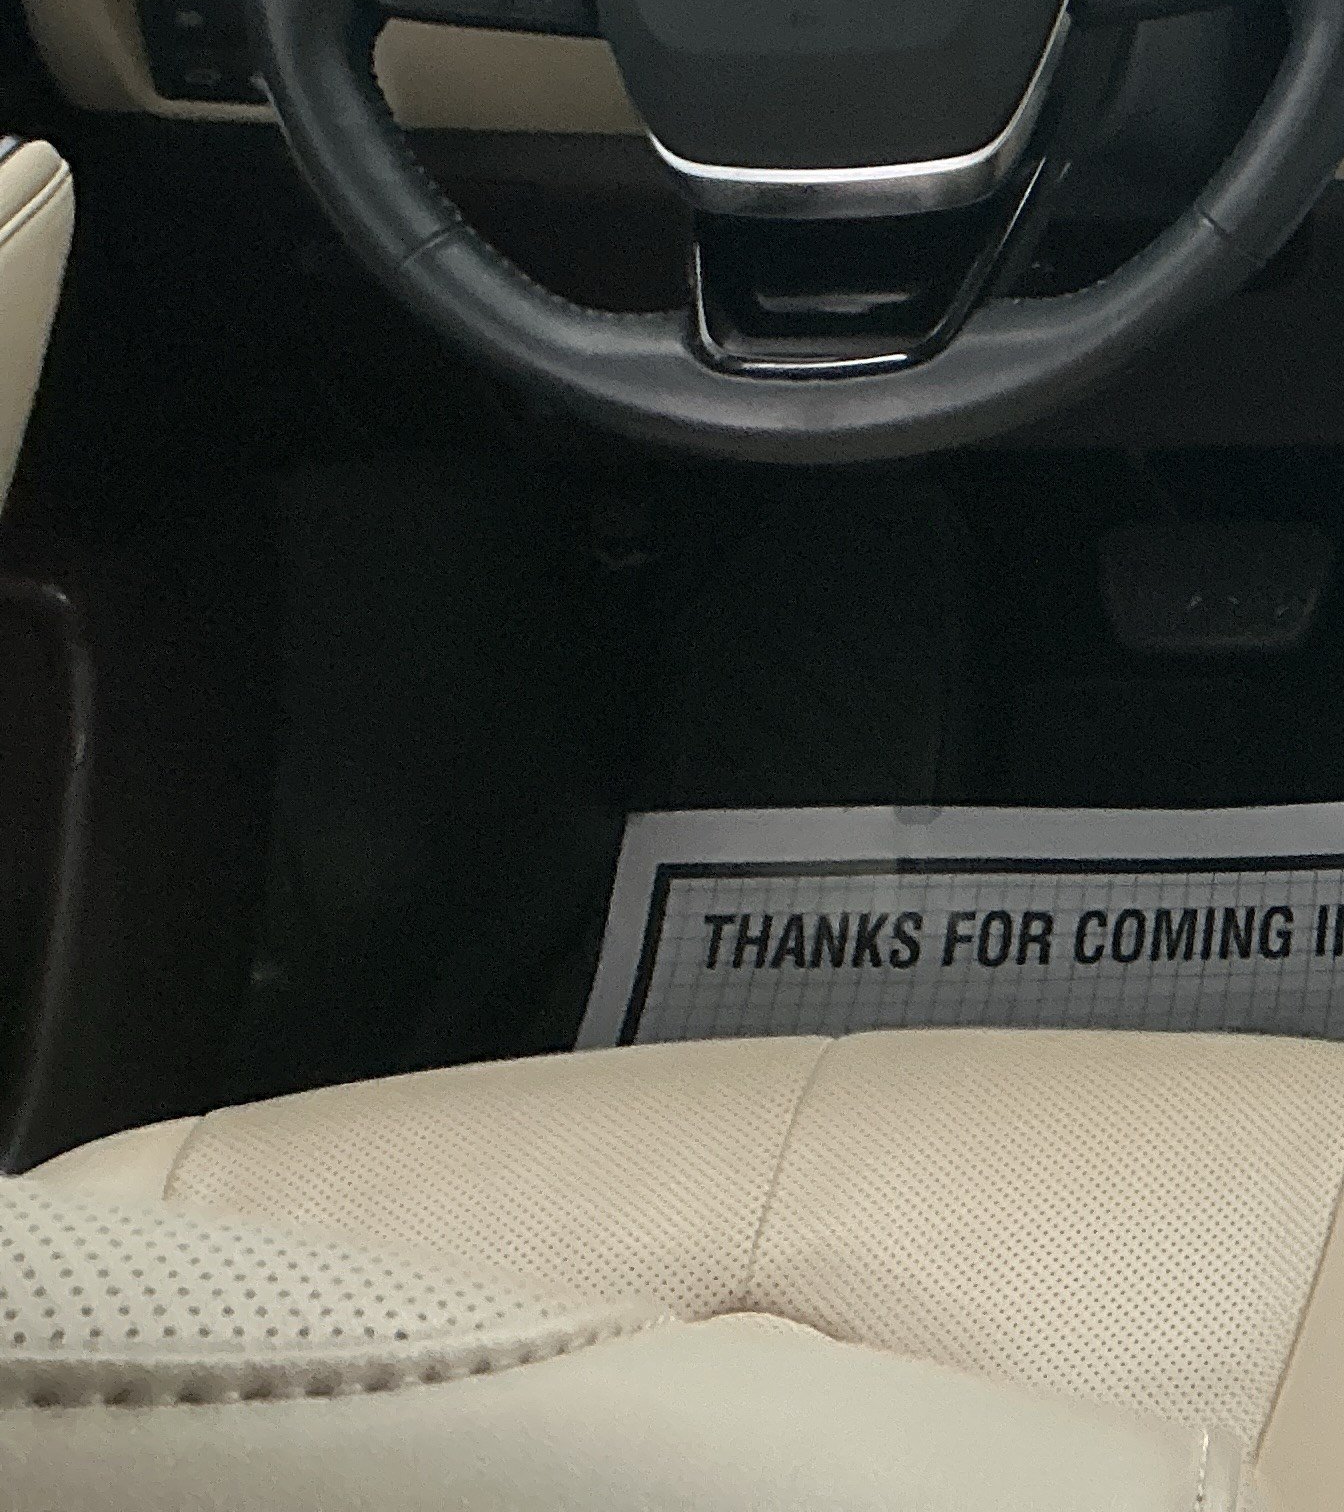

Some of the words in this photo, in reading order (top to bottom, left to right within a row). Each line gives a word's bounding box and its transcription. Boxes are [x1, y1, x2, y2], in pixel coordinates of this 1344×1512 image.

[703, 911, 923, 970] THANKS
[941, 910, 1053, 967] FOR
[1074, 904, 1294, 966] COMING
